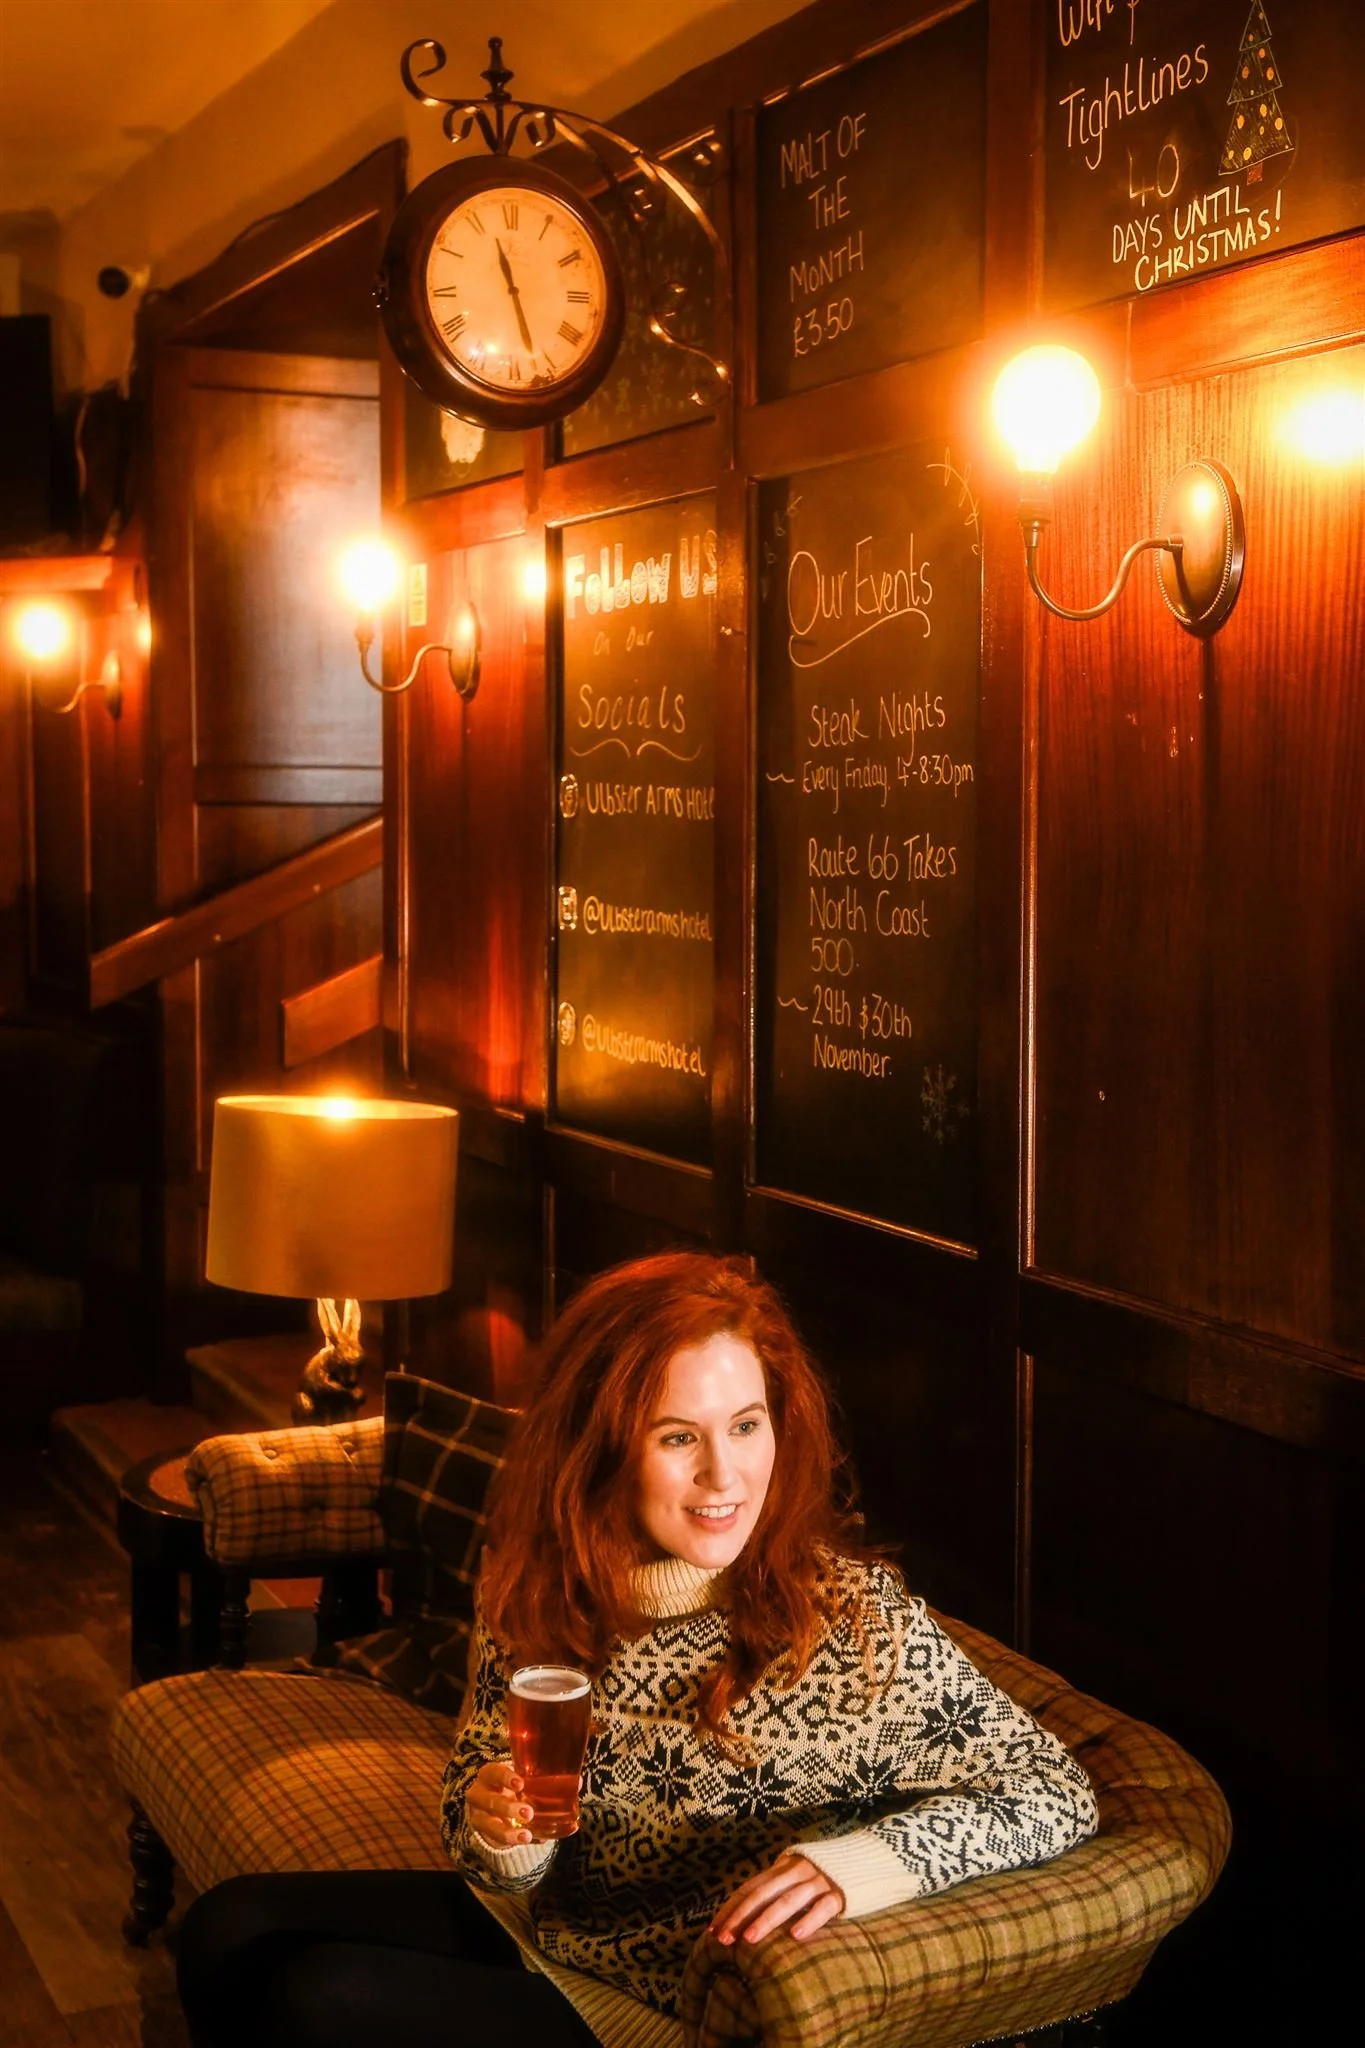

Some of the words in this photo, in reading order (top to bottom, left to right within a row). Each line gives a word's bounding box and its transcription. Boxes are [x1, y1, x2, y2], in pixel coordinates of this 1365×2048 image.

[781, 130, 831, 189] MALT
[837, 112, 866, 158] OF
[1127, 143, 1179, 207] 40
[808, 175, 850, 229] THE
[1112, 213, 1163, 264] DAYS
[1174, 185, 1250, 240] UNTIL
[789, 230, 864, 303] MONTH
[1134, 189, 1282, 291] CHRISTMAS!
[794, 297, 854, 358] £3.50
[788, 551, 848, 635] Our
[855, 533, 932, 616] Events
[577, 679, 686, 734] Socials
[807, 697, 870, 748] Steak
[878, 691, 947, 767] Nights
[802, 760, 840, 814] Every
[808, 834, 860, 878] Route
[868, 833, 899, 881] 66
[903, 832, 957, 882] Takes
[810, 885, 867, 932] North
[876, 889, 931, 938] Coast
[812, 984, 851, 1028] 29th
